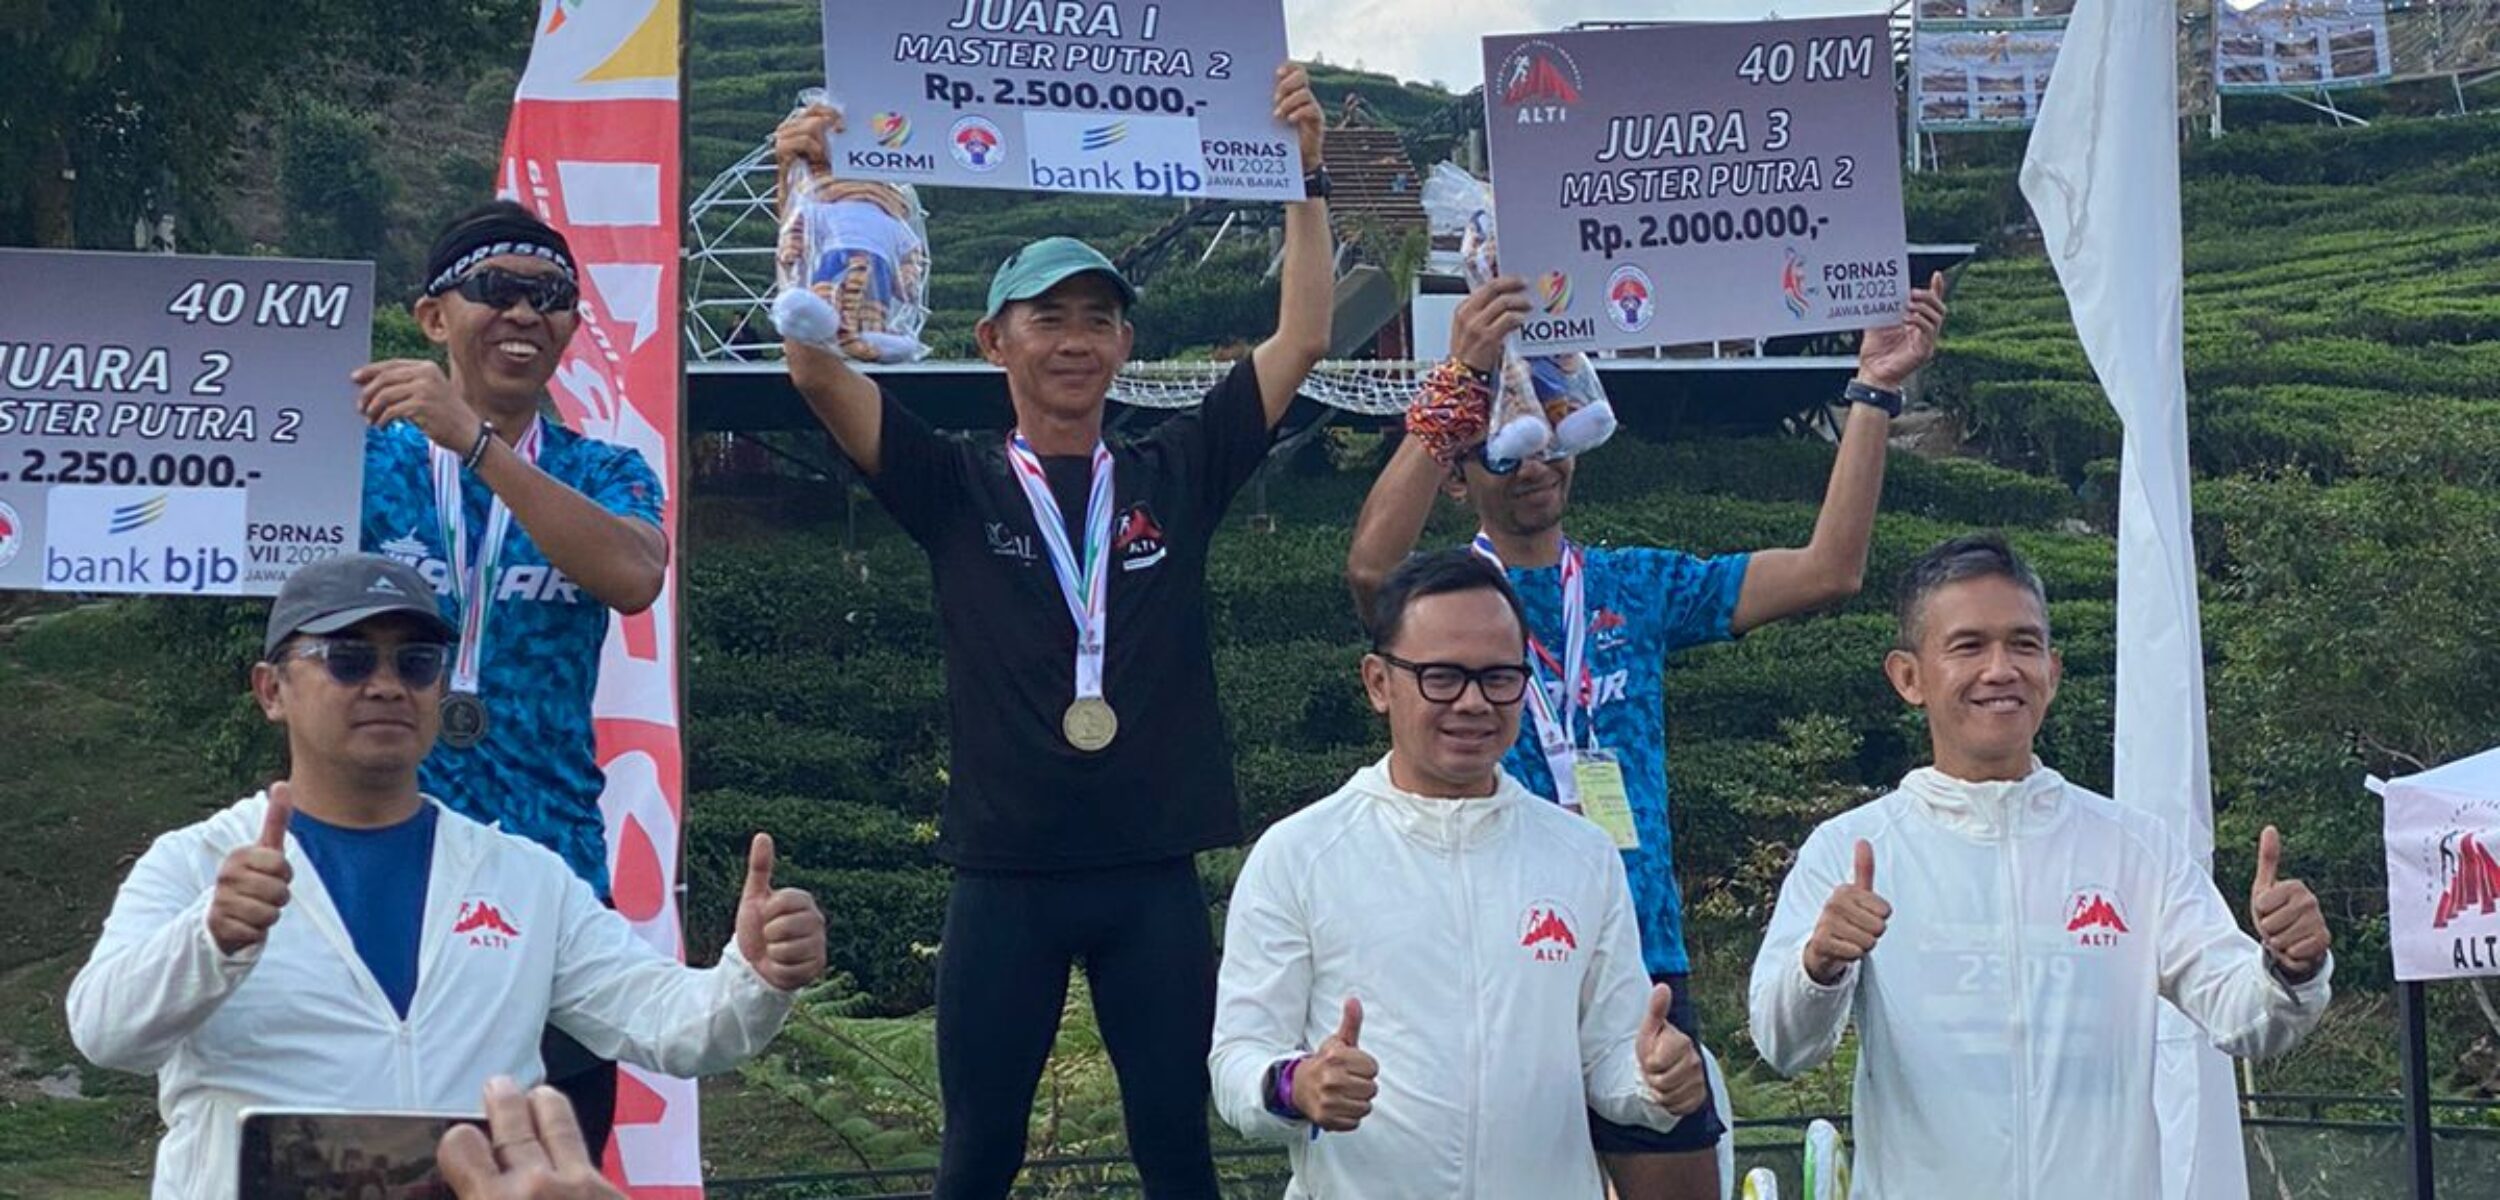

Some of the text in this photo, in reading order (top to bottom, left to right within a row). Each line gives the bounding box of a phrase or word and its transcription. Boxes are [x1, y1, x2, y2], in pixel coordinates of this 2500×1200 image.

[950, 0, 1121, 37] JUARA
[896, 35, 1232, 79] MASTER PUTRA 2
[1738, 36, 1875, 84] 40 KM
[925, 74, 1207, 117] Rp. 2.500.000,-
[1517, 105, 1567, 123] ALTI
[1597, 107, 1791, 161] JUARA 3
[848, 151, 935, 169] KORMI
[1201, 140, 1287, 157] FORNAS
[1031, 158, 1201, 196] bank bjb
[1205, 157, 1287, 174] VII 2023
[1206, 175, 1291, 188] JAWA BARAT
[1560, 156, 1856, 207] MASTER PUTRA 2
[1579, 204, 1830, 259] Rp. 2.000.000,-
[1823, 260, 1898, 281] FORNAS
[1826, 279, 1897, 300] VII 2023
[169, 280, 351, 328] 40 KM
[1520, 317, 1595, 340] KORMI
[191, 350, 232, 395] 2
[109, 403, 256, 441] PUTRA
[270, 408, 303, 443] 2
[247, 523, 344, 544] FORNAS
[249, 545, 279, 562] VII
[48, 548, 238, 590] bank bjb
[470, 935, 508, 950] ALTI
[2081, 933, 2118, 946] ALTI
[1535, 949, 1569, 962] ALTI
